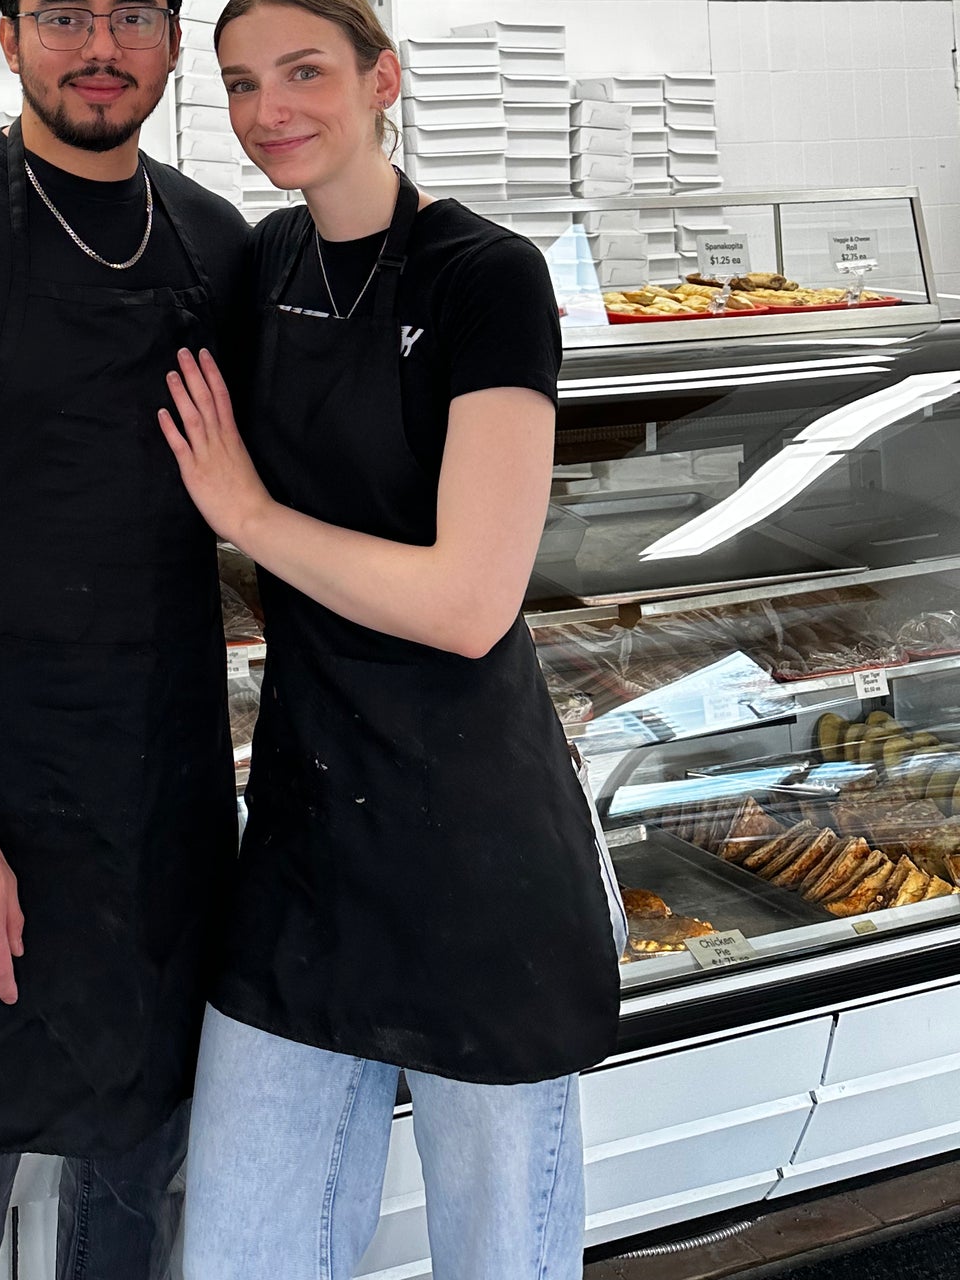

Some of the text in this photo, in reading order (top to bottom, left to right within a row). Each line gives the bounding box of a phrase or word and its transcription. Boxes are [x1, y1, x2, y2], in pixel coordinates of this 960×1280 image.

[705, 242, 743, 251] Spanakopita
[710, 255, 730, 265] $1.25
[699, 936, 736, 949] Chicken
[714, 948, 732, 958] Pie
